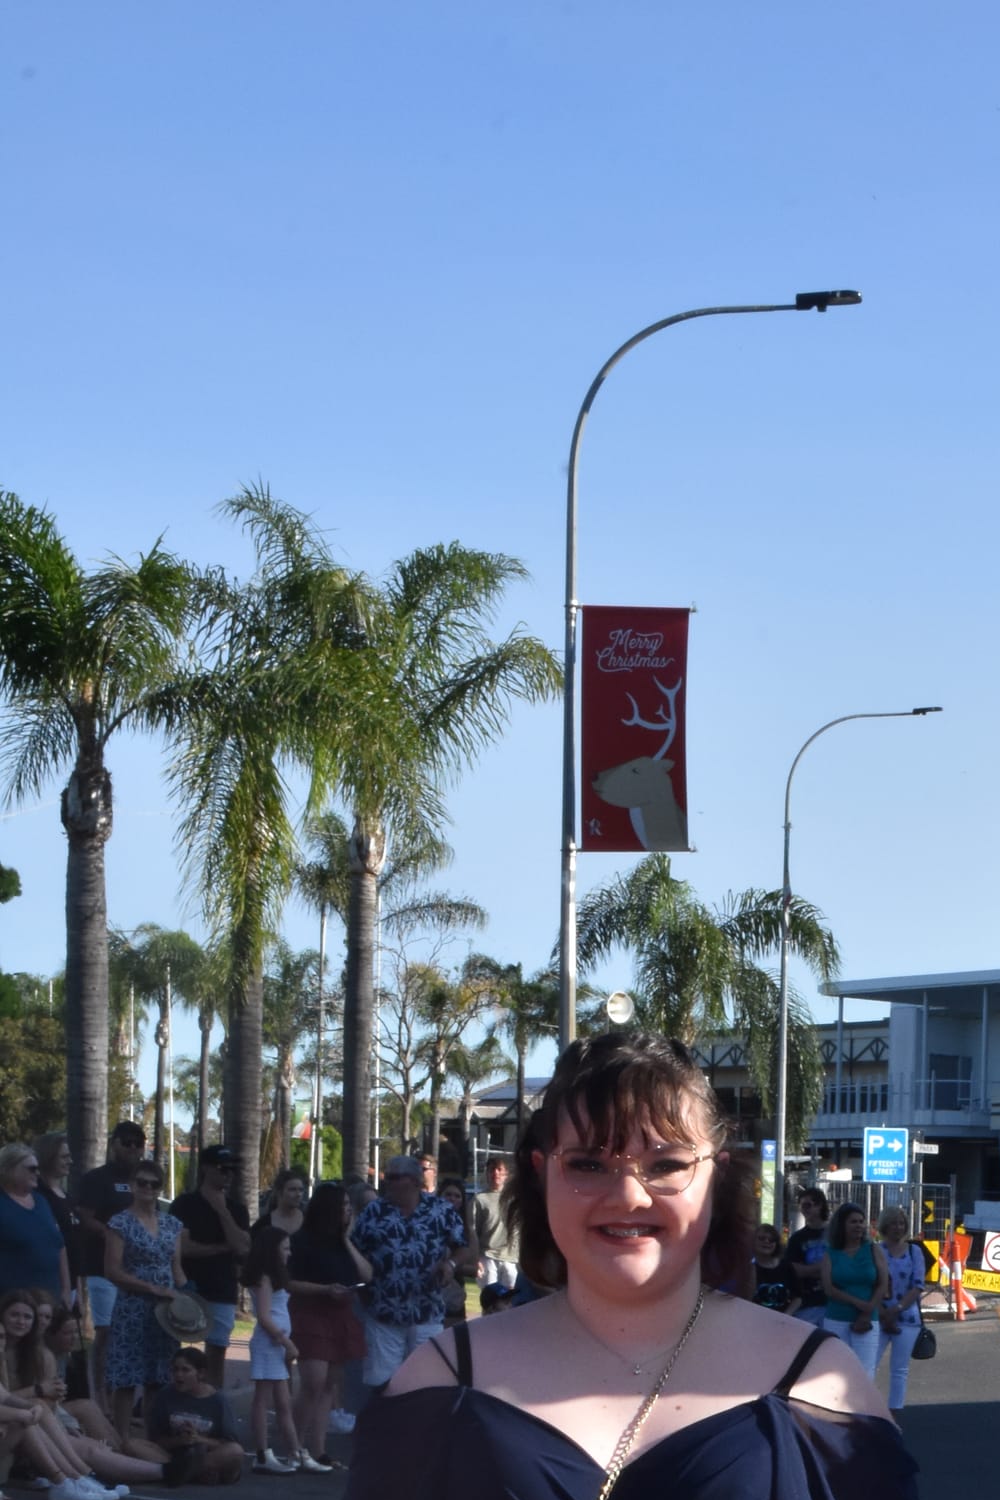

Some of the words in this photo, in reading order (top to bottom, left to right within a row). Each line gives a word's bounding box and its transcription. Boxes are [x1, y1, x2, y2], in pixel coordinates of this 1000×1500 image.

[609, 628, 664, 656] Merry
[595, 647, 675, 672] Christmas
[868, 1135, 885, 1155] P
[872, 1167, 898, 1176] STREET
[961, 1272, 986, 1287] DWORK
